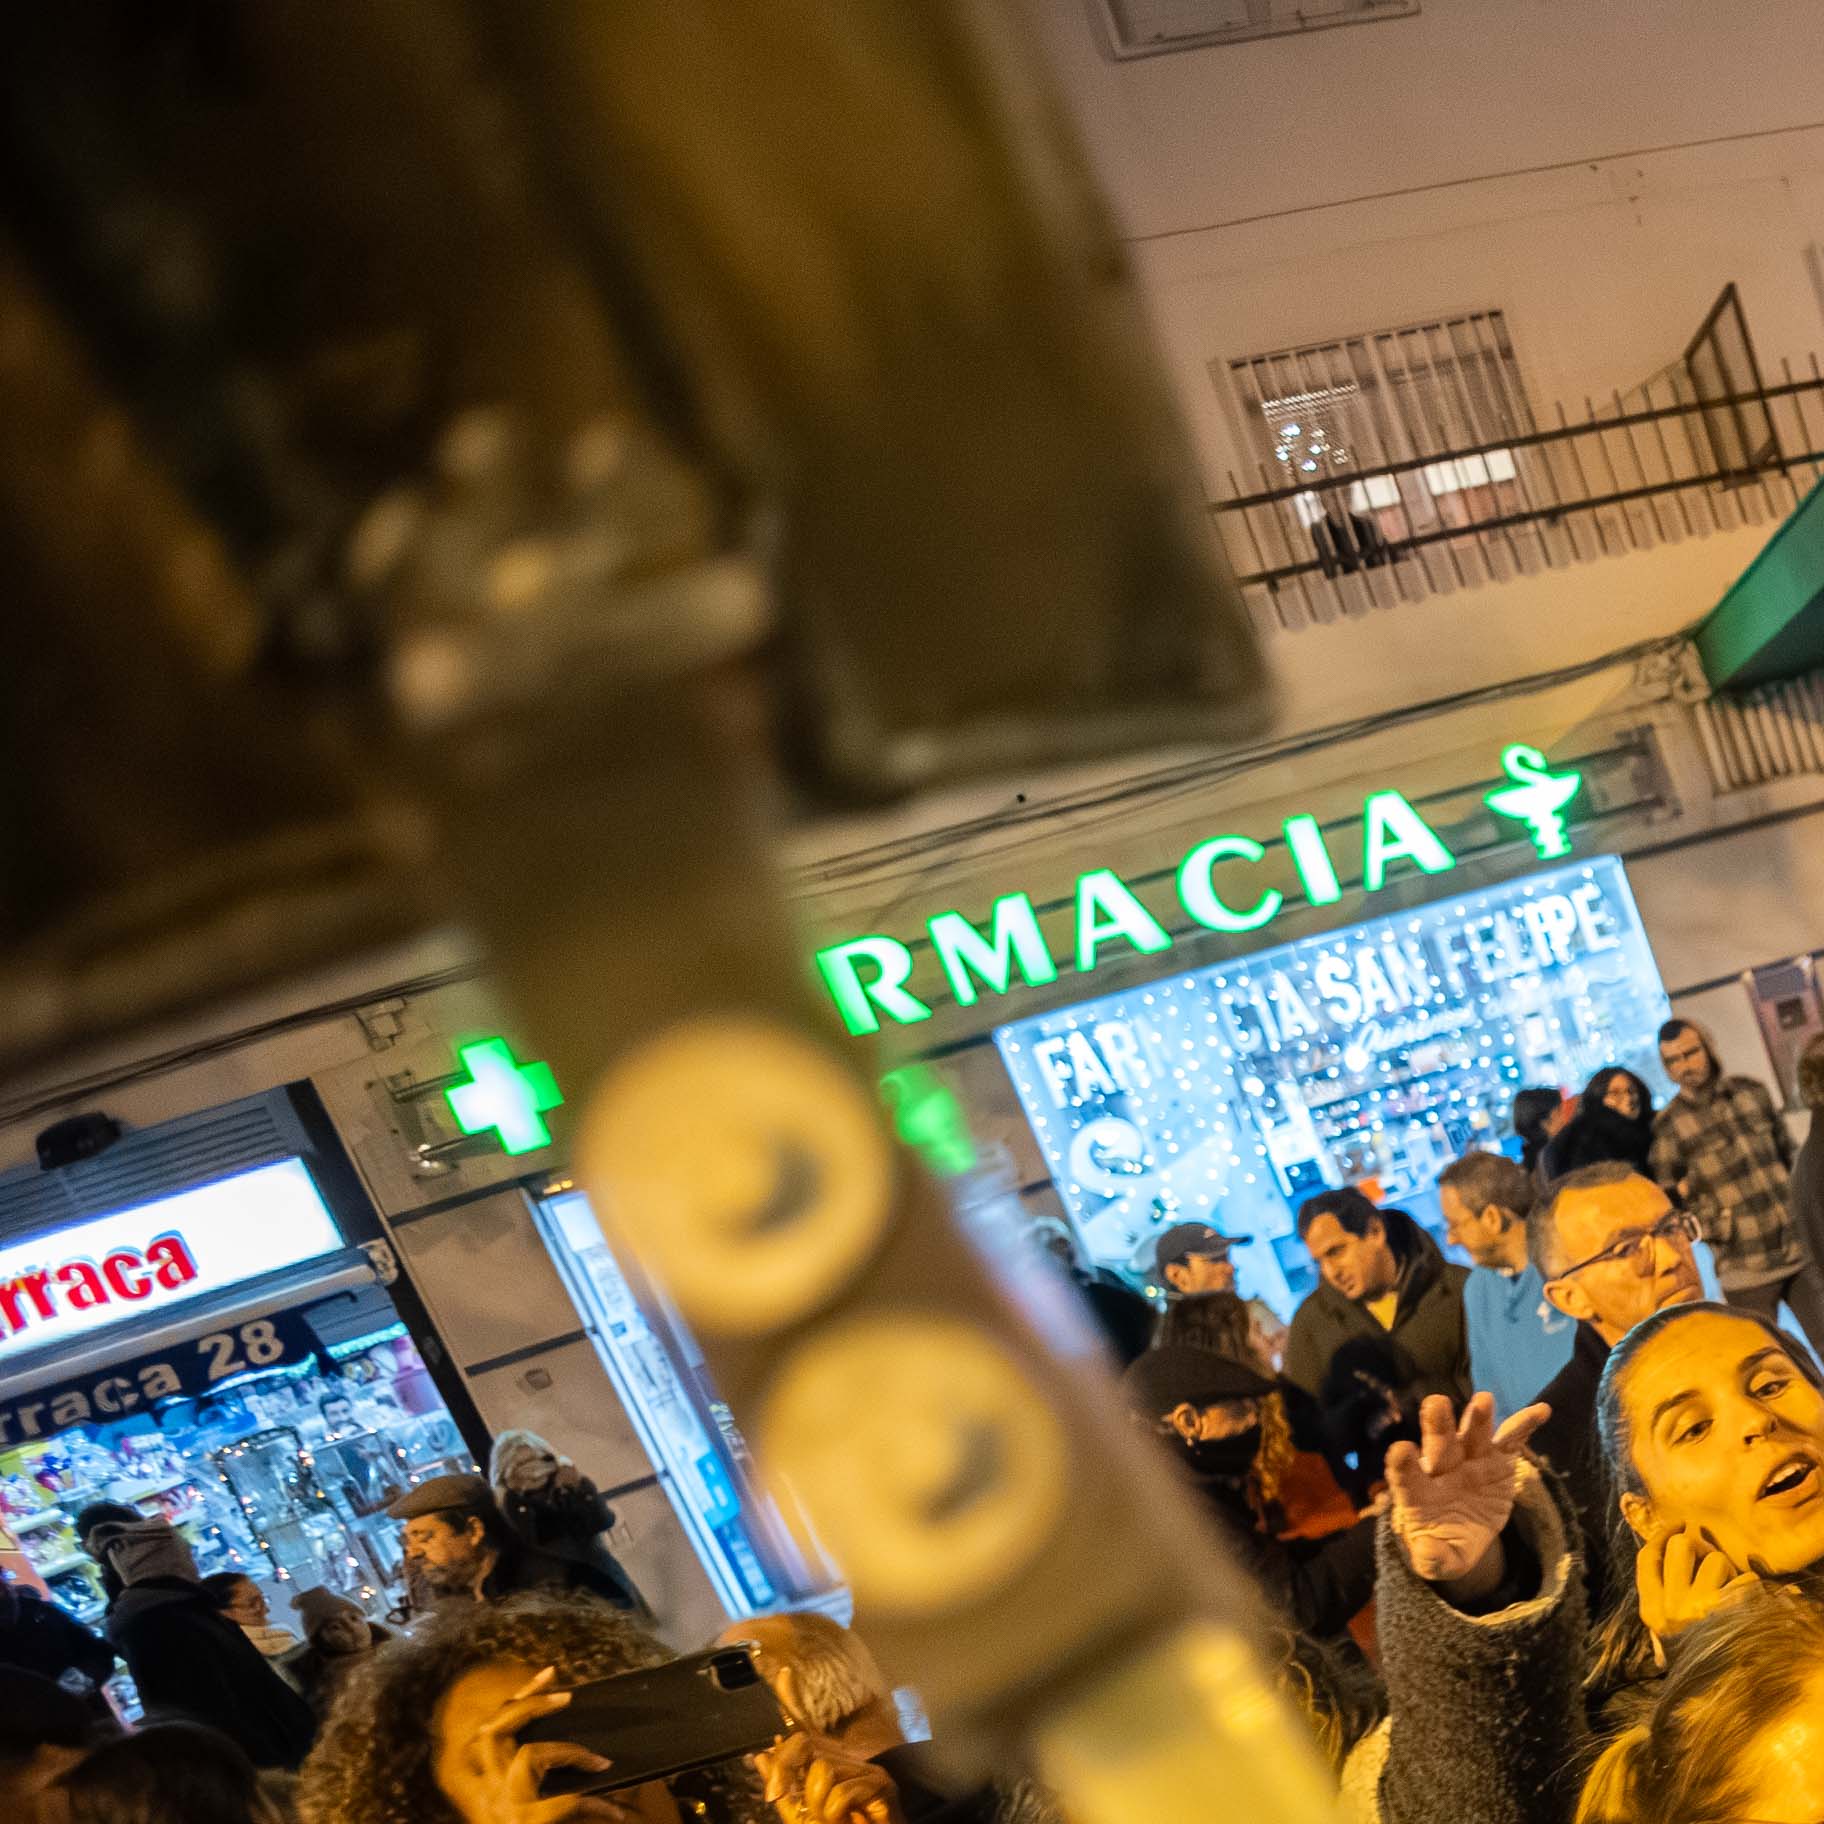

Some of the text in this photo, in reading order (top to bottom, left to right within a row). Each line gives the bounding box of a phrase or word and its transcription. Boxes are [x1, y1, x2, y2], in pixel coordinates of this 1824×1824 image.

[817, 788, 1457, 1036] RMACIA
[1032, 968, 1320, 1109] FARCIA
[1315, 938, 1433, 1025] SAN
[1434, 886, 1621, 999] FELIPE
[0, 1232, 198, 1341] rraca
[197, 1319, 285, 1381] 28
